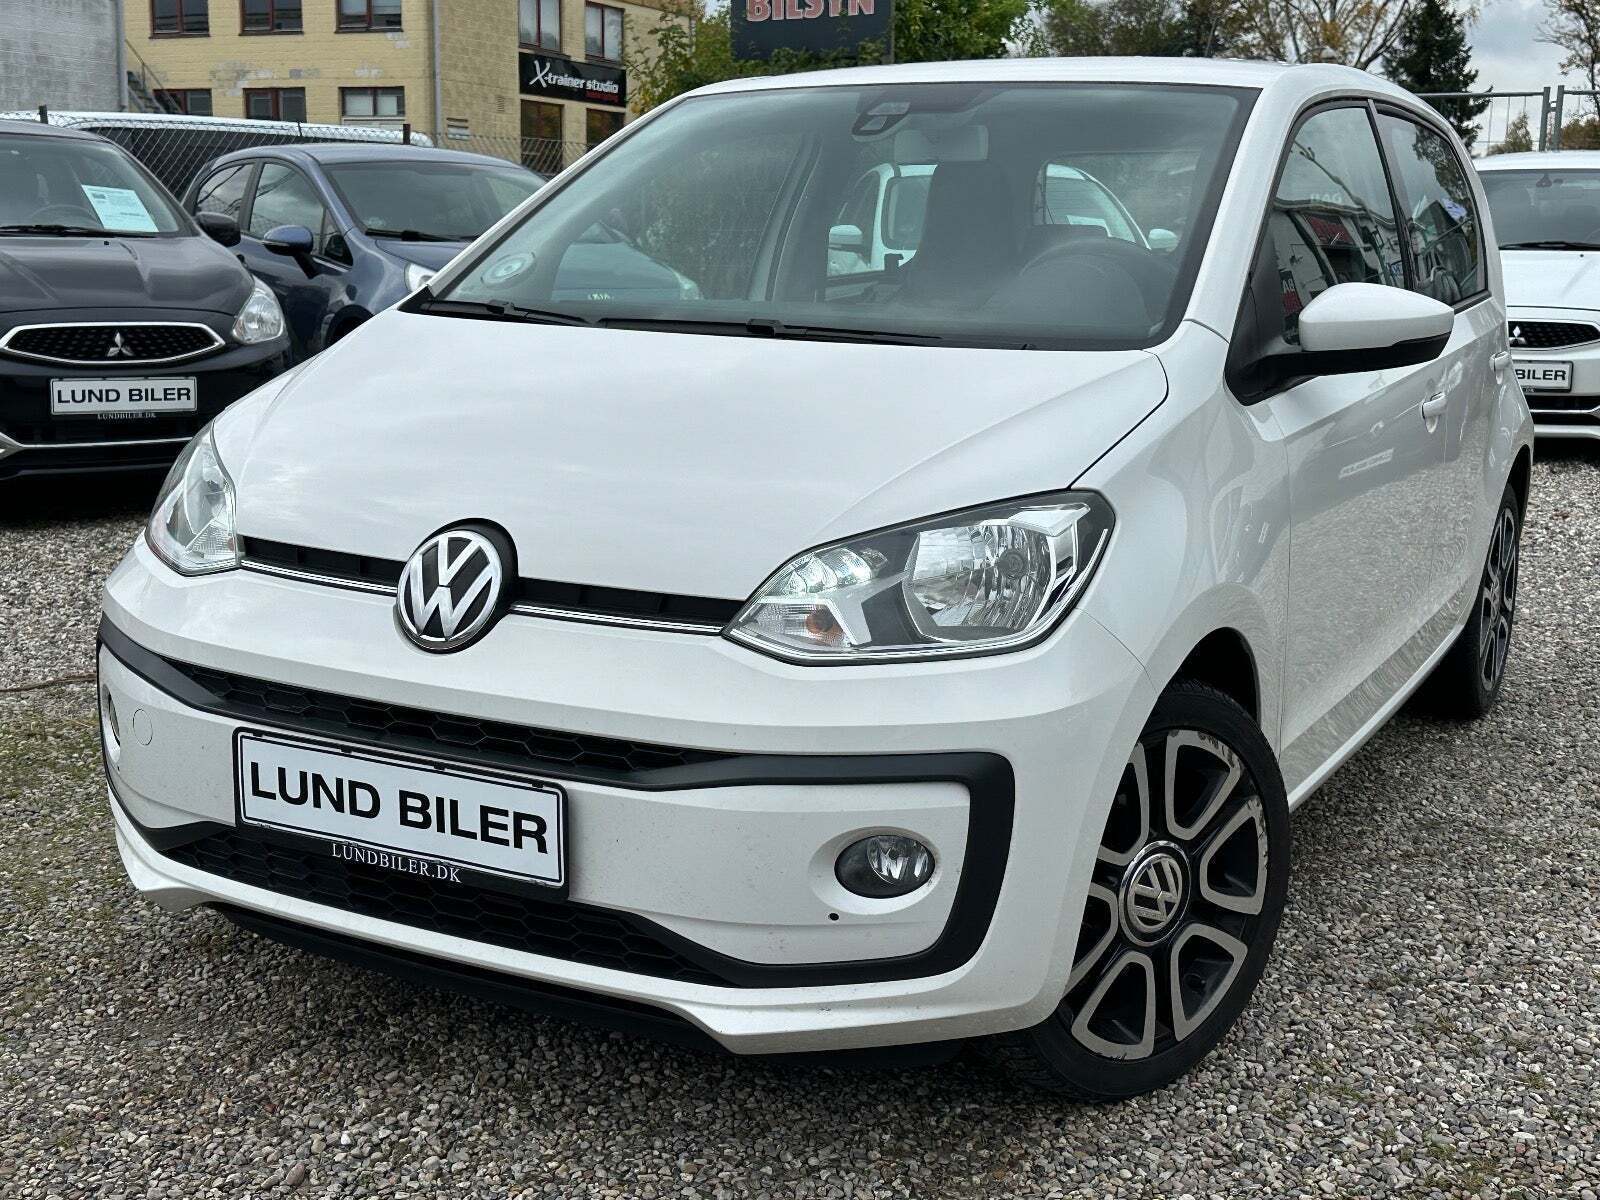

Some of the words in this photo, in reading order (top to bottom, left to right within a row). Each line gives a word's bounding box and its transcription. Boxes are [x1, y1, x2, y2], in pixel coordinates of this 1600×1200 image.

[529, 60, 585, 88] X-trainer
[586, 80, 619, 94] studio
[1515, 369, 1567, 381] BILER
[57, 388, 121, 404] LUND
[128, 387, 192, 401] BILER
[250, 762, 381, 819] LUND
[399, 789, 549, 855] BILER
[332, 843, 463, 884] LUNDBILER.DK
